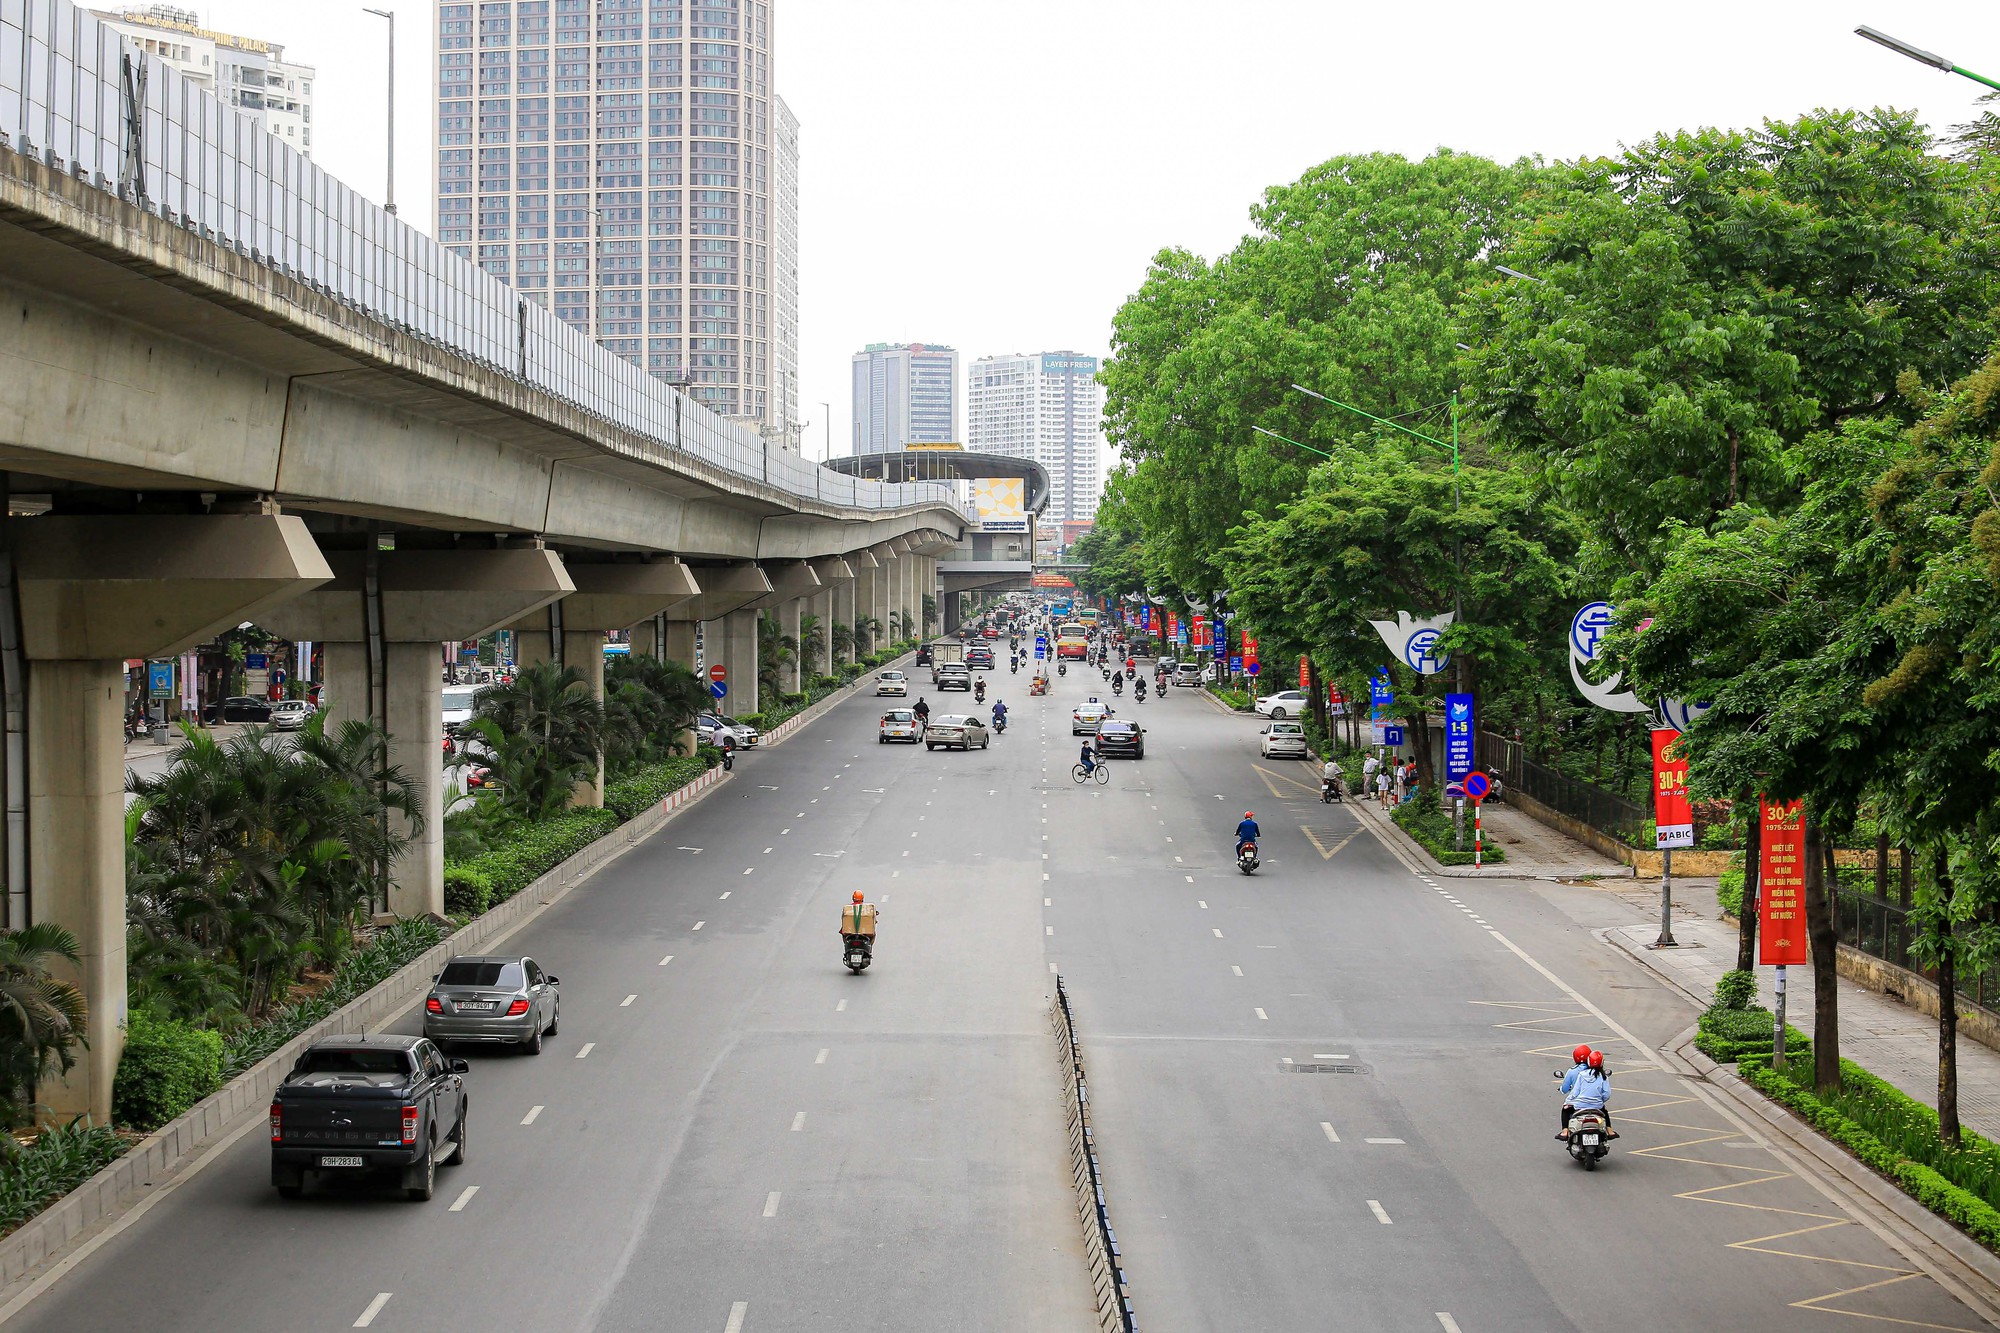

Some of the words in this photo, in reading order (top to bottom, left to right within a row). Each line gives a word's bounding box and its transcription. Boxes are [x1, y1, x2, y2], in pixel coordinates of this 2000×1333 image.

[238, 36, 269, 53] PALACE
[1045, 360, 1069, 369] LAYER
[1070, 361, 1093, 369] FRESH
[1451, 721, 1468, 733] 1-5
[1659, 770, 1684, 790] 30-4
[1668, 830, 1691, 839] ABIC
